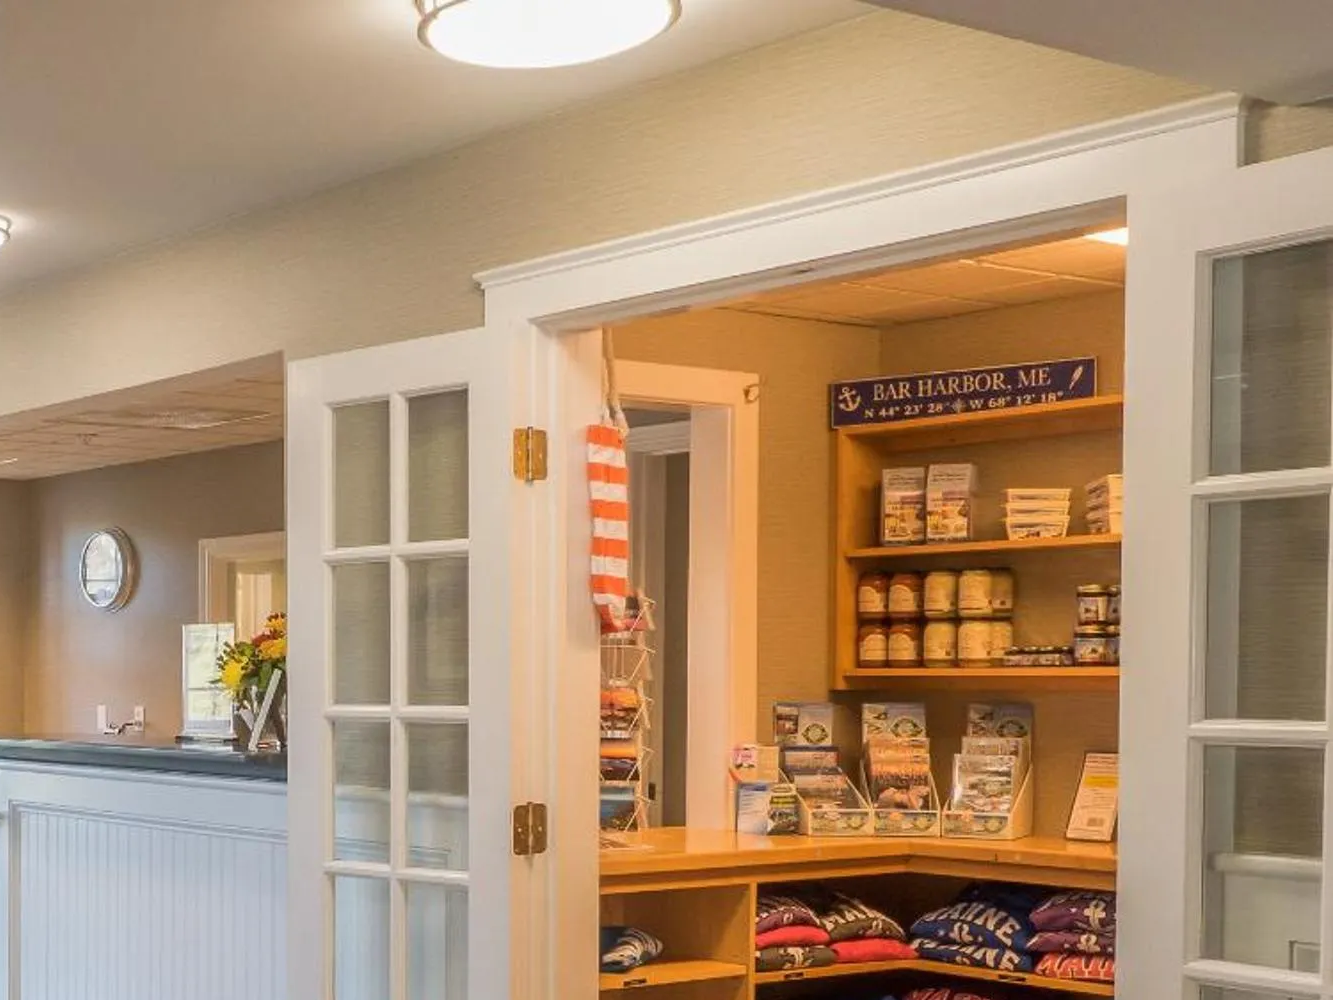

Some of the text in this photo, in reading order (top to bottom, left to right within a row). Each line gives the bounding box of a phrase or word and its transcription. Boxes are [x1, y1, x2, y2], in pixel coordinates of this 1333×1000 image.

[873, 367, 1051, 401] BAR HARBOR, ME
[864, 408, 874, 418] N
[969, 399, 984, 410] W
